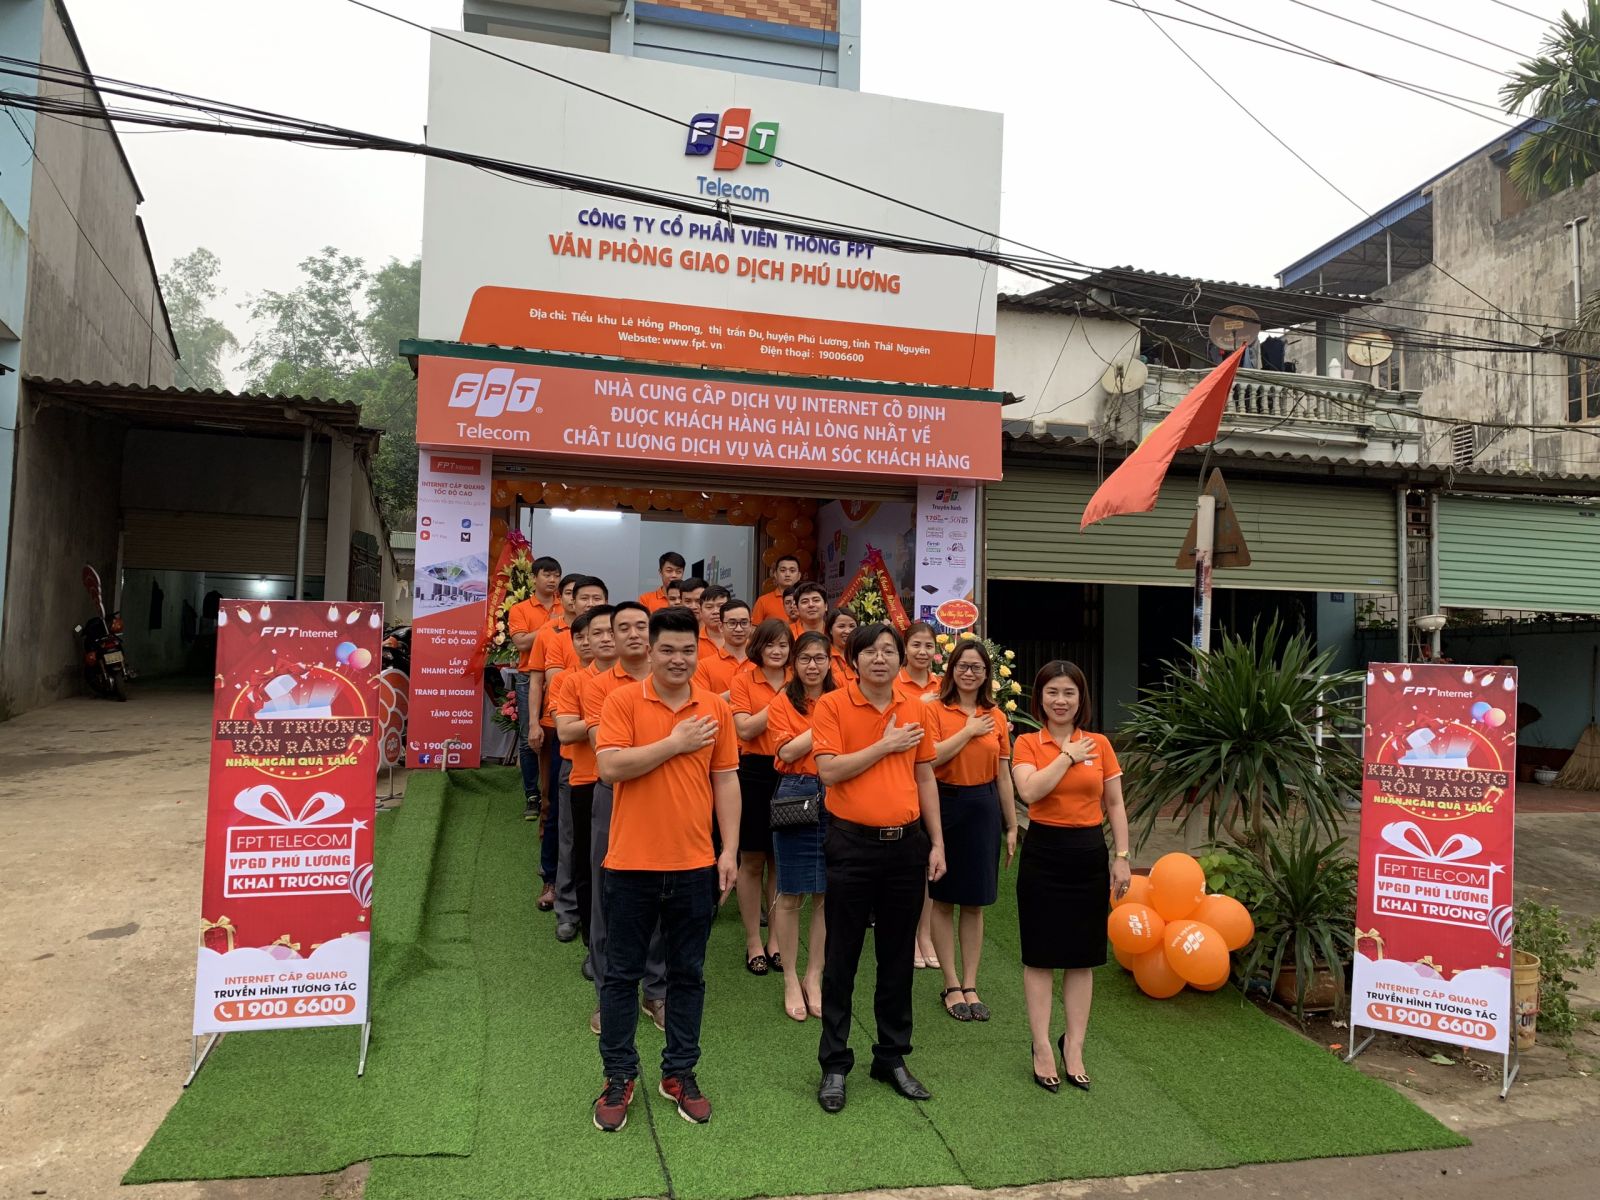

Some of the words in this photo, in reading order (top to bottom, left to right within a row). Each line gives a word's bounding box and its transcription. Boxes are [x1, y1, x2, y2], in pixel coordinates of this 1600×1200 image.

[688, 114, 778, 160] FPT
[697, 176, 769, 202] Telecom
[578, 208, 627, 230] CÔNG
[633, 216, 656, 234] TY
[660, 214, 683, 236] CỔ
[847, 242, 874, 260] FPT
[549, 232, 592, 258] VĂN
[599, 237, 673, 268] PHÒNG
[680, 250, 730, 274] GIAO
[737, 257, 784, 283] DỊCH
[790, 262, 831, 286] PHÚ
[836, 267, 901, 294] LƯƠNG
[530, 309, 547, 320] Địa
[597, 314, 617, 325] khu
[622, 316, 633, 326] Lê
[669, 321, 703, 335] Phong,
[709, 325, 722, 337] thị
[767, 331, 794, 344] huyện
[798, 334, 815, 344] Phú
[820, 336, 851, 349] Lương,
[874, 341, 893, 351] Thái
[897, 343, 931, 356] Nguyên
[618, 331, 661, 344] Website:
[760, 345, 782, 357] Điện
[819, 350, 864, 363] 19006600
[452, 375, 538, 410] FPT
[594, 378, 634, 398] NHÀ
[640, 383, 687, 403] CUNG
[692, 384, 726, 405] CẤP
[731, 391, 769, 411] DỊCH
[775, 395, 797, 414] VỤ
[802, 397, 878, 416] INTERNET
[907, 404, 945, 423] ĐỊNH
[456, 422, 530, 442] Telecom
[611, 406, 659, 428] ĐƯỢC
[664, 410, 723, 430] KHÁCH
[729, 413, 776, 434] HÀNG
[782, 417, 810, 436] HÀI
[816, 419, 858, 439] LÒNG
[864, 422, 907, 443] NHẤT
[564, 425, 611, 447] CHẤT
[616, 432, 676, 453] LƯỢNG
[681, 437, 720, 456] DỊCH
[726, 441, 749, 459] VỤ
[753, 439, 774, 458] VÀ
[778, 442, 827, 461] CHĂM
[832, 444, 862, 463] SÓC
[867, 447, 921, 467] KHÁCH
[925, 450, 970, 470] HÀNG
[261, 626, 299, 637] FPT
[300, 629, 338, 638] Internet
[432, 636, 446, 644] TỐC
[448, 636, 458, 646] ĐỘ
[421, 667, 447, 675] NHANH
[415, 689, 438, 697] TRANG
[440, 689, 447, 698] BỊ
[449, 689, 475, 697] MODEM
[1403, 686, 1437, 696] FPT
[1437, 690, 1472, 698] Internet
[430, 709, 450, 718] TẶNG
[218, 721, 273, 735] KHAI
[234, 735, 281, 755] RỘN
[286, 736, 346, 754] RÀNG
[262, 755, 295, 767] NGÀN
[298, 755, 323, 766] QUÀ
[1368, 763, 1415, 779] KHAI
[1381, 778, 1421, 795] RỘN
[1426, 783, 1482, 798] RÀNG
[1406, 797, 1434, 808] NGÀN
[1437, 800, 1461, 811] QUÀ
[237, 836, 263, 849] FPT
[268, 834, 347, 848] TELECOM
[230, 858, 266, 870] VPGD
[272, 855, 300, 868] PHÚ
[305, 855, 350, 867] LƯƠNG
[233, 876, 273, 890] KHAI
[279, 874, 348, 888] TRƯƠNG
[1384, 863, 1407, 876] FPT
[1411, 866, 1485, 886] TELECOM
[1378, 881, 1410, 894] VPGD
[1415, 886, 1440, 898] PHÚ
[1445, 889, 1489, 904] LƯƠNG
[1381, 898, 1417, 913] KHAI
[1421, 904, 1486, 921] TRƯƠNG
[225, 975, 275, 985] INTERNET
[278, 971, 302, 982] CÁP
[306, 970, 347, 980] QUANG
[260, 984, 288, 996] HÌNH
[292, 983, 331, 994] TƯƠNG
[335, 981, 357, 991] TÁC
[1375, 982, 1420, 995] INTERNET
[1423, 989, 1445, 999] CÁP
[1448, 994, 1488, 1007] QUANG
[236, 1000, 288, 1018] 1900
[294, 997, 346, 1014] 6600
[1406, 997, 1432, 1009] HÌNH
[1435, 1002, 1472, 1016] TƯƠNG
[1475, 1010, 1497, 1021] TÁC
[1386, 1006, 1432, 1027] 1900
[1437, 1016, 1487, 1037] 6600
